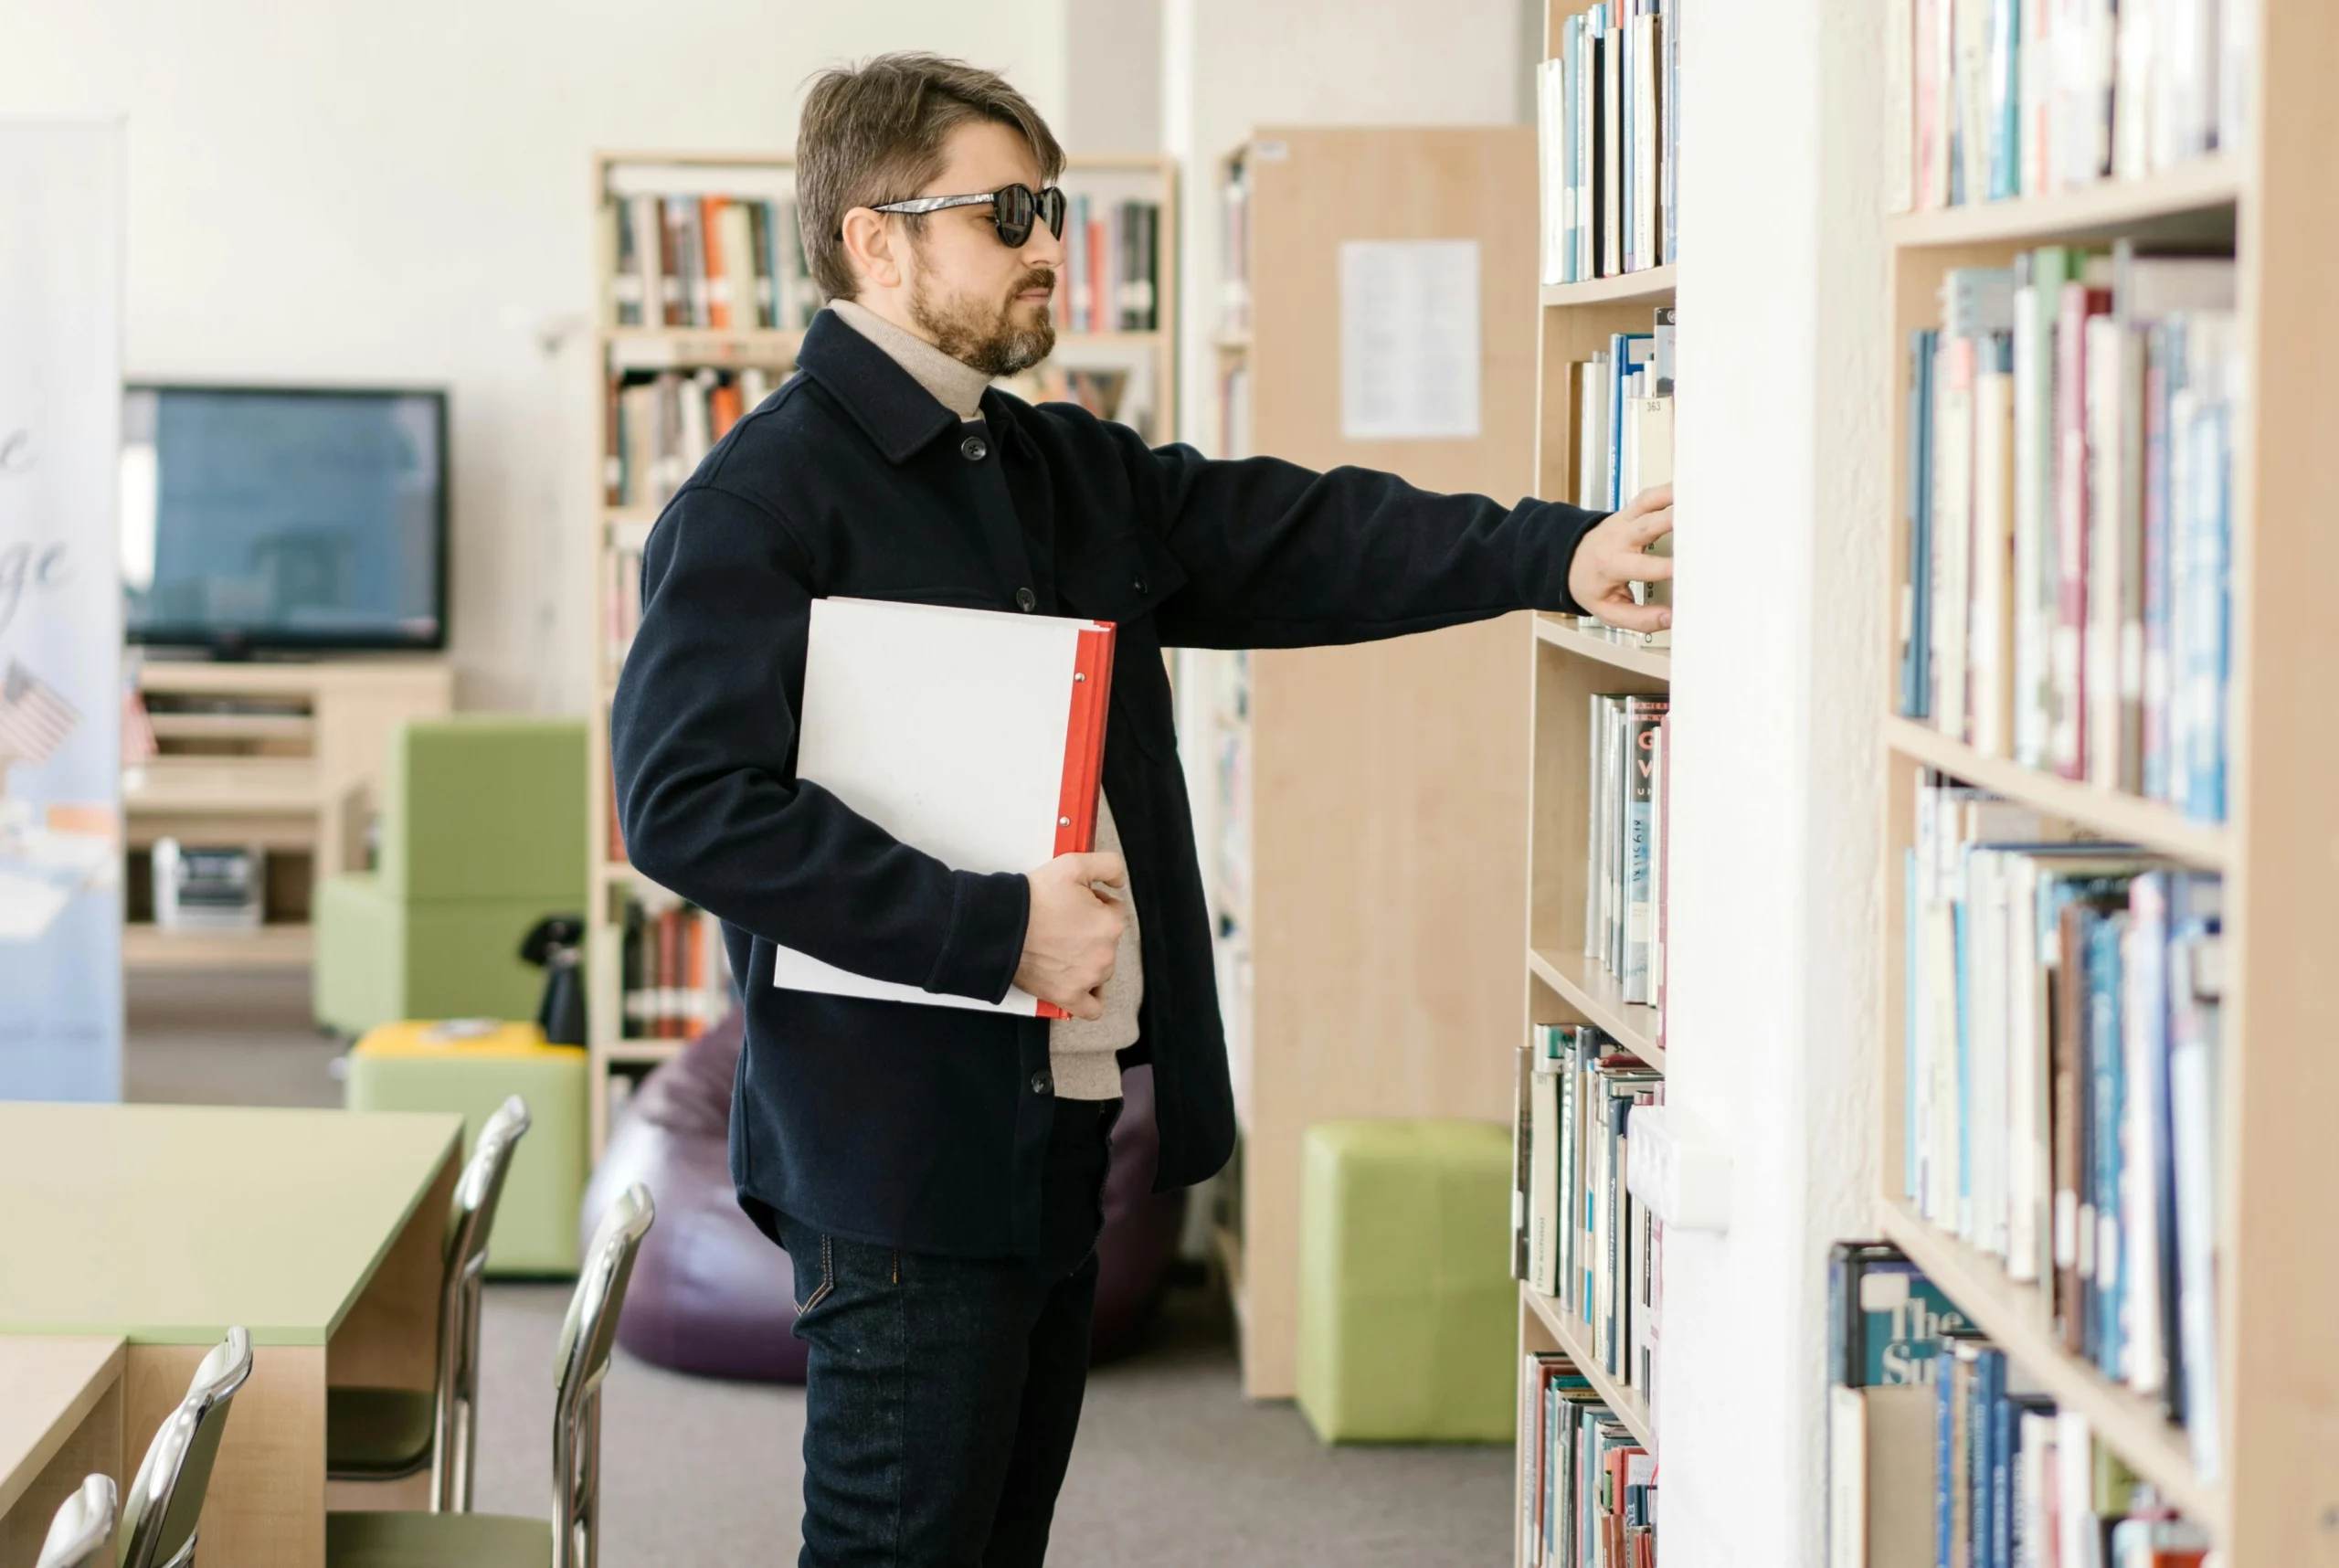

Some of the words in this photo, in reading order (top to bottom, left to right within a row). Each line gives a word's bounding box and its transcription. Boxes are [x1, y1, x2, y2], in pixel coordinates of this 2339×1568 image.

[1646, 401, 1660, 412] 363
[1888, 1296, 1965, 1341] The
[1882, 1341, 1935, 1385] Su
